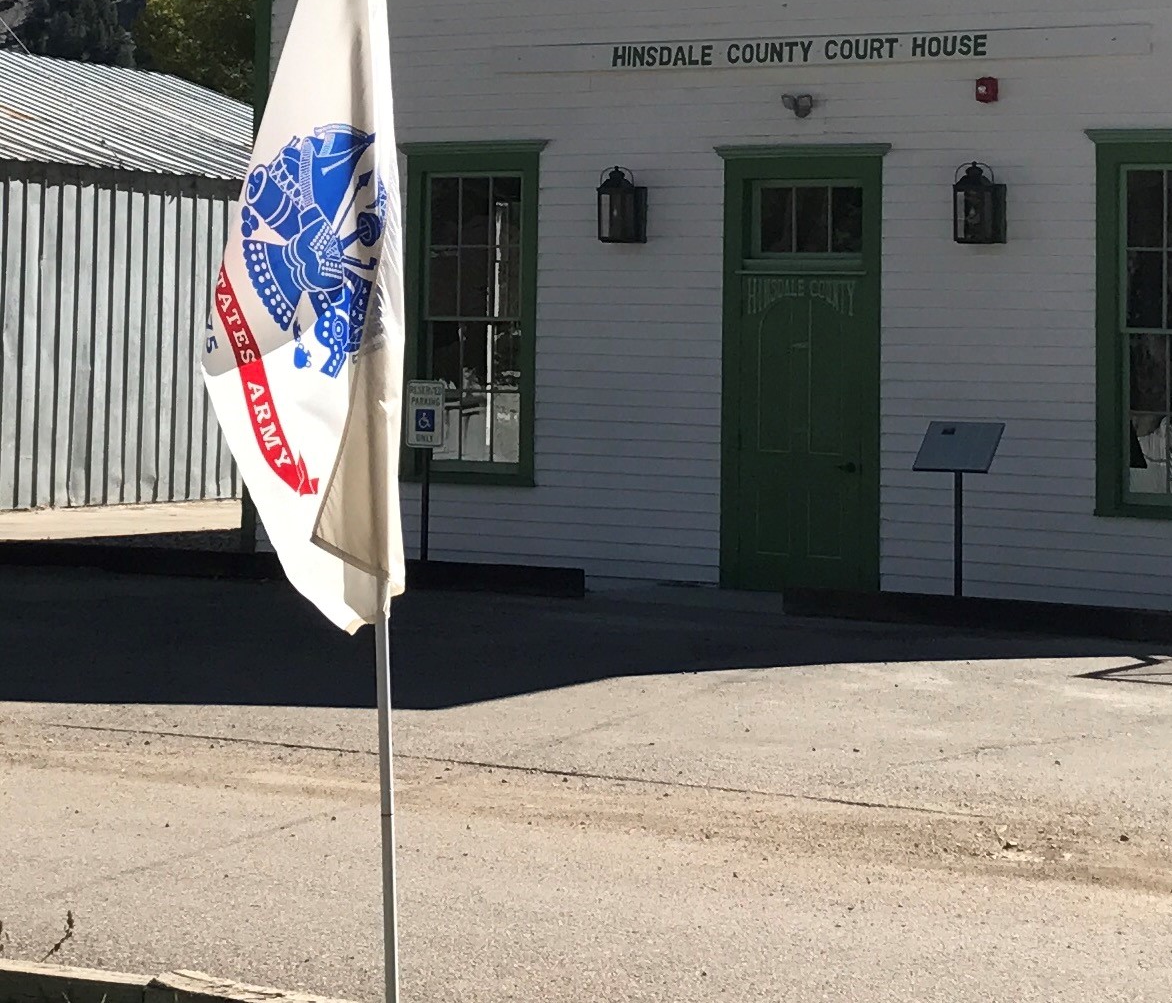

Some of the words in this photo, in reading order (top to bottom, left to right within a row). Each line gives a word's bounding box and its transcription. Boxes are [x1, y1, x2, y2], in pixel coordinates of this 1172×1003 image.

[612, 45, 713, 67] HINSDALE
[727, 41, 813, 64] COUNTY
[825, 38, 899, 60] COURT
[911, 34, 987, 57] HOUSE
[747, 277, 804, 314] HINSDALE
[810, 279, 857, 316] COUNTY
[216, 271, 257, 364] TATES
[247, 380, 292, 469] ARMY
